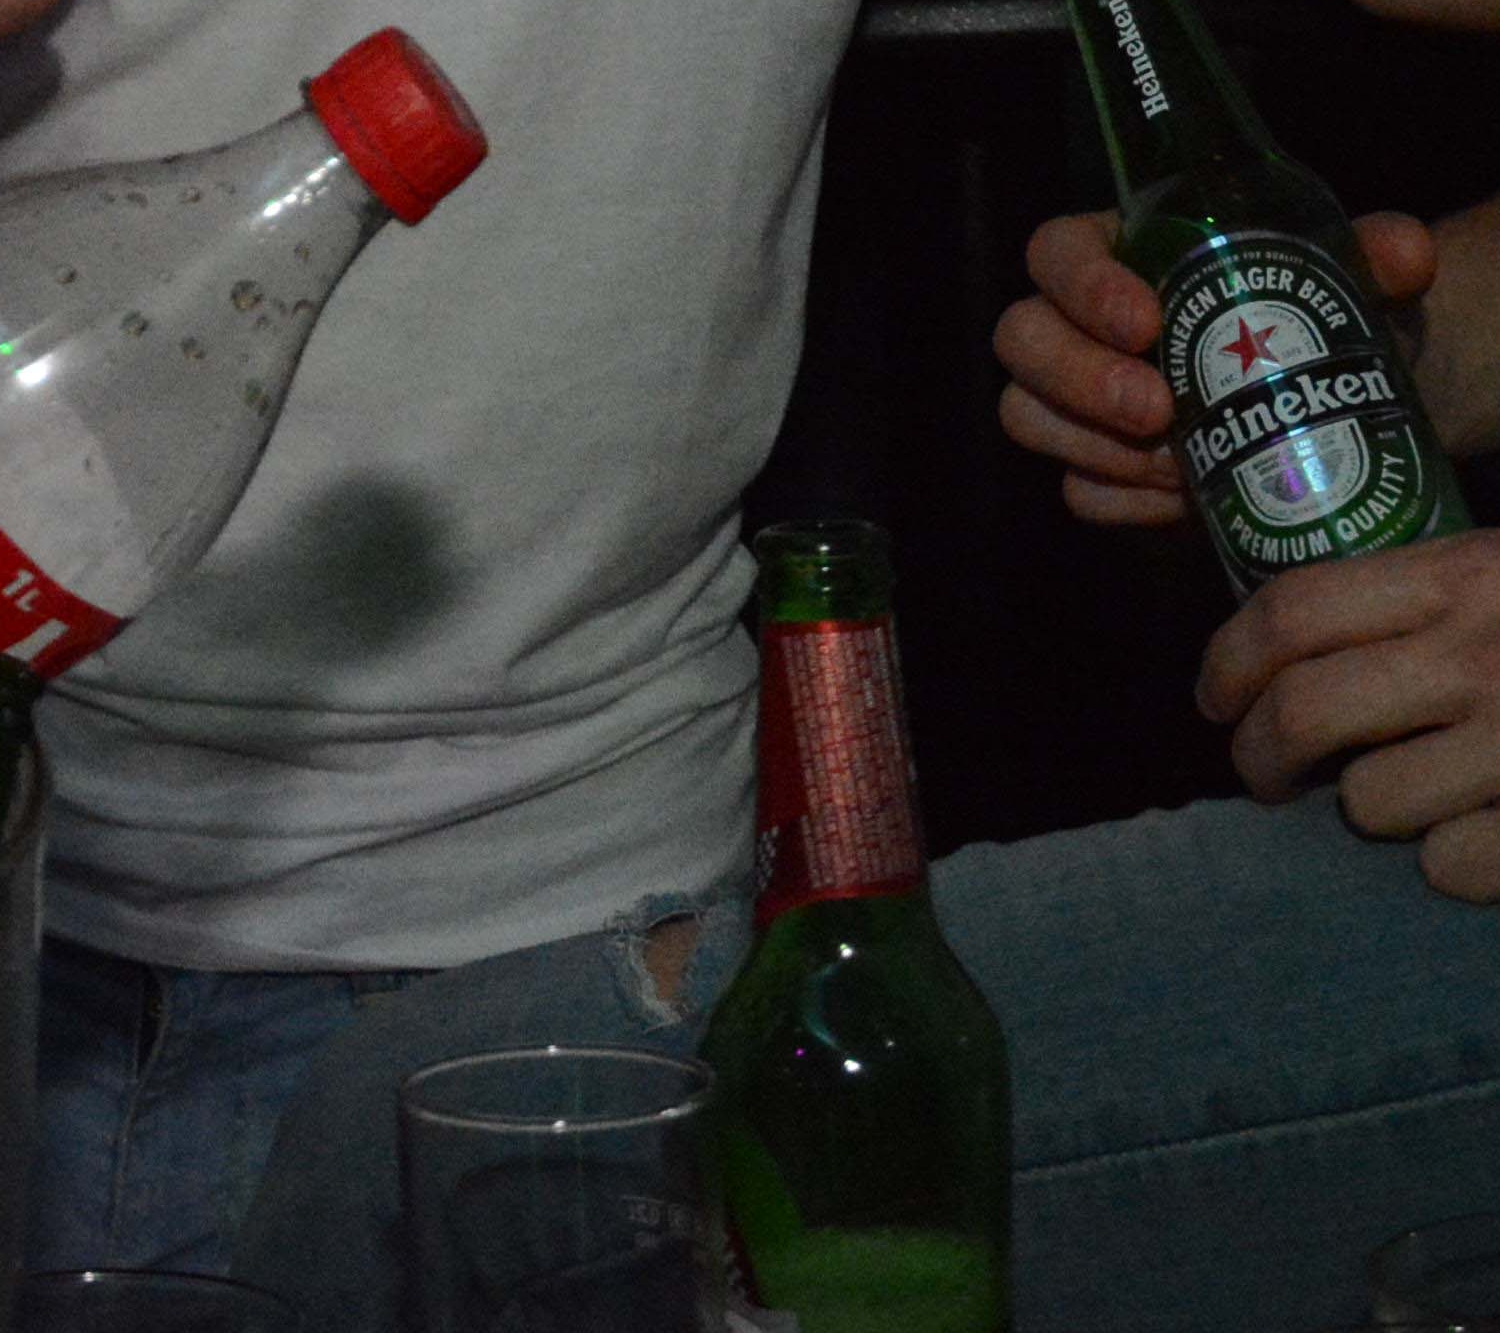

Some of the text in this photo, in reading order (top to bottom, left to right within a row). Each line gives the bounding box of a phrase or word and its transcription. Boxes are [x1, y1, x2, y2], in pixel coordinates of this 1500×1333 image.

[1168, 285, 1218, 397] HEINEKEN
[1217, 266, 1296, 300] LAGER
[1296, 278, 1349, 331] BEER
[1184, 366, 1397, 480] Heineken
[1229, 513, 1333, 563] PREMIUM
[1335, 452, 1406, 542] QUALITY
